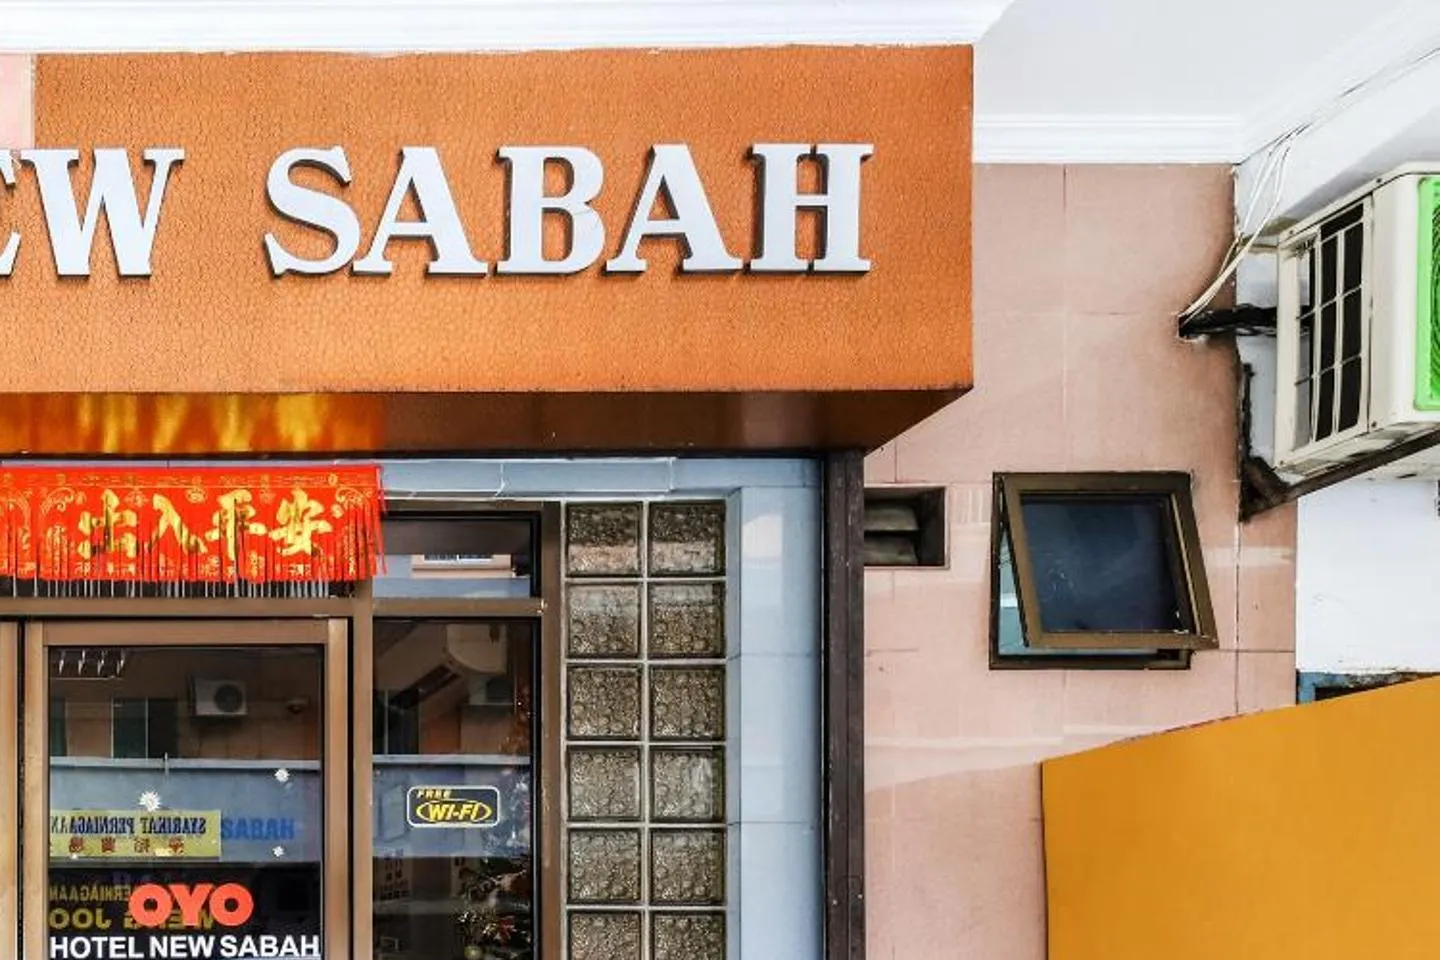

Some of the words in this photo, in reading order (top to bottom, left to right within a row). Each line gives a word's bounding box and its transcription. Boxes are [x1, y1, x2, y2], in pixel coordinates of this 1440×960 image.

[262, 142, 874, 278] SABAH
[415, 788, 452, 799] FREE
[427, 803, 481, 821] WI-FI
[128, 883, 254, 928] OYO
[49, 935, 145, 959] HOTEL
[149, 935, 216, 959] NEW
[219, 934, 322, 958] SABAH
